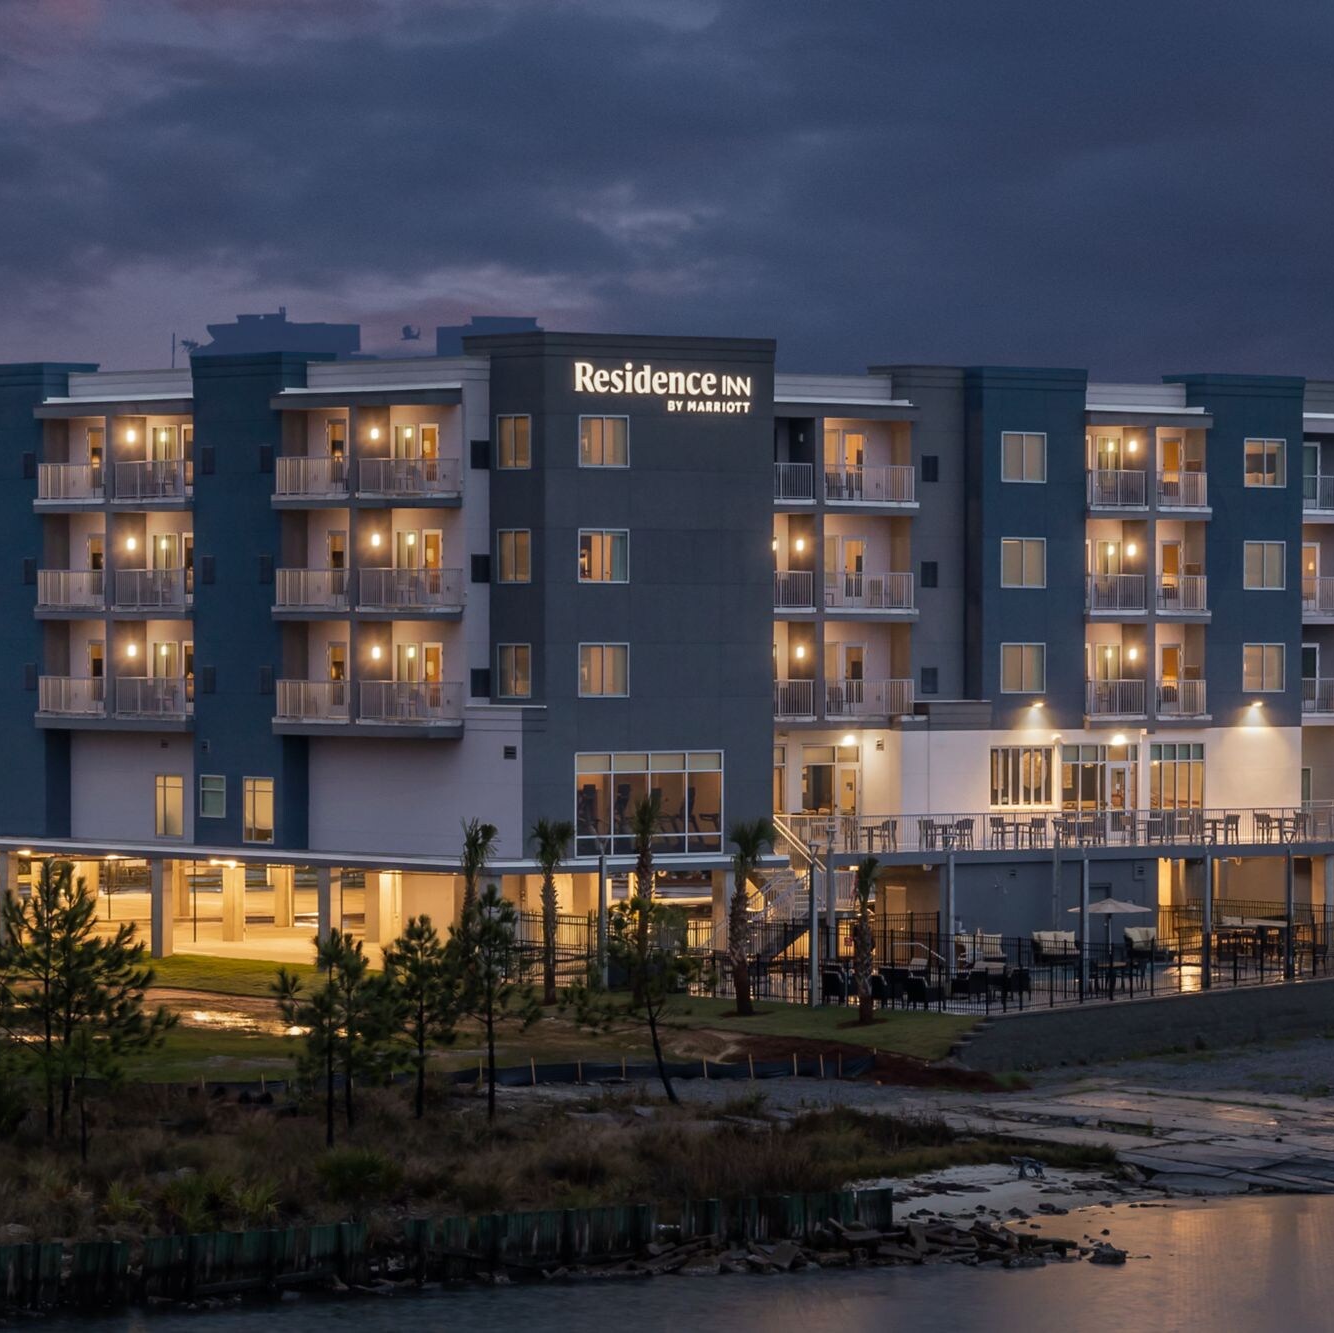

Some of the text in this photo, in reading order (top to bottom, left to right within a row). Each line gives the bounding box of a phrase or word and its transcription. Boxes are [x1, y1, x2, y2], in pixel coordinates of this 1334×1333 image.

[574, 362, 751, 397] Residence INN
[667, 400, 751, 413] BY MARRIOTT
